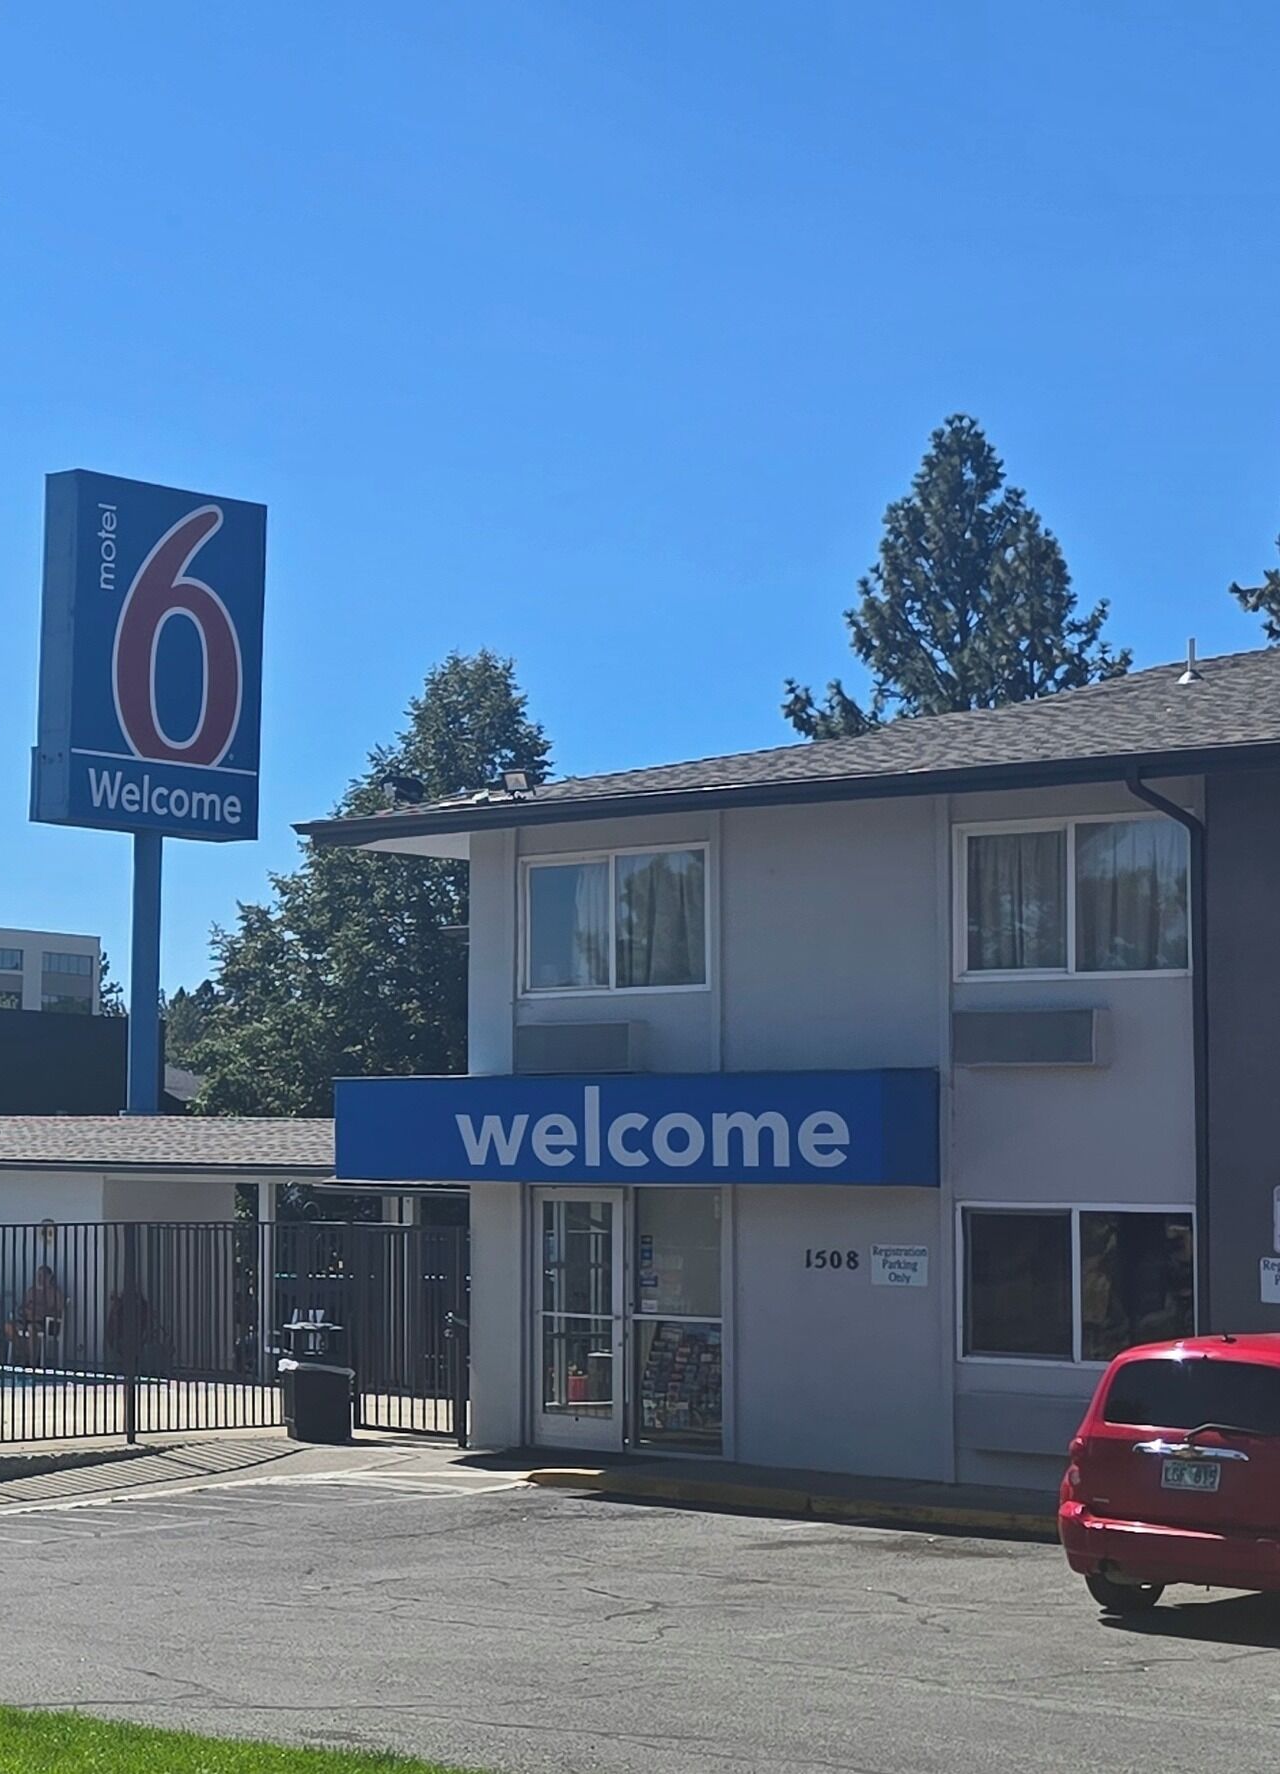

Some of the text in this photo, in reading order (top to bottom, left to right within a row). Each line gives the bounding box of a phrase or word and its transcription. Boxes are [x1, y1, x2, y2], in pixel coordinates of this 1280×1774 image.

[98, 502, 244, 768] motel 6
[88, 766, 242, 824] Welcome
[454, 1085, 851, 1168] welcome
[805, 1249, 860, 1270] 1508
[882, 1258, 918, 1272] Parking
[888, 1271, 912, 1284] Only
